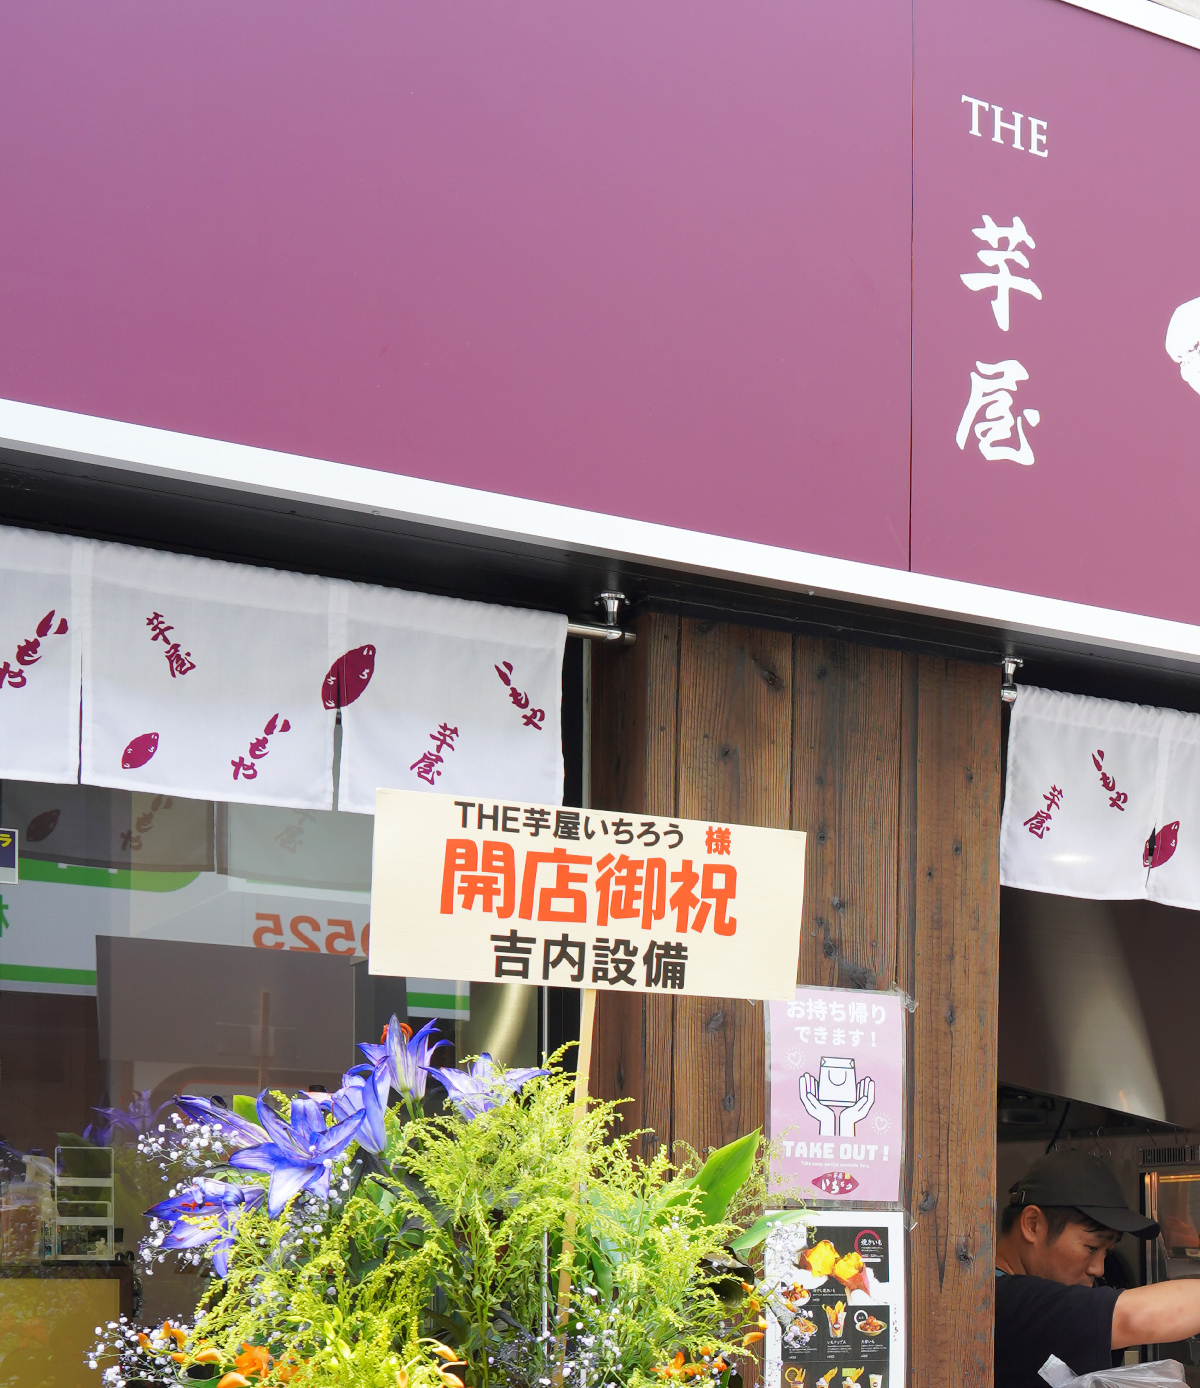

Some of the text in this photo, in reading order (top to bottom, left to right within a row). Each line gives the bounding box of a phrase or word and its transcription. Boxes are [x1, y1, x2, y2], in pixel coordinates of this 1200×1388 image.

[961, 94, 1048, 158] THE
[956, 214, 1042, 466] 芋屋
[146, 611, 196, 678] 芋屋
[231, 713, 291, 781] いもや
[410, 722, 459, 785] 芋屋
[454, 801, 732, 856] THE芋屋いちろう 様
[440, 838, 738, 937] 開店御祝
[490, 929, 689, 990] 吉内設備
[786, 998, 887, 1026] お持ち帰り
[782, 1140, 835, 1160] TAKE
